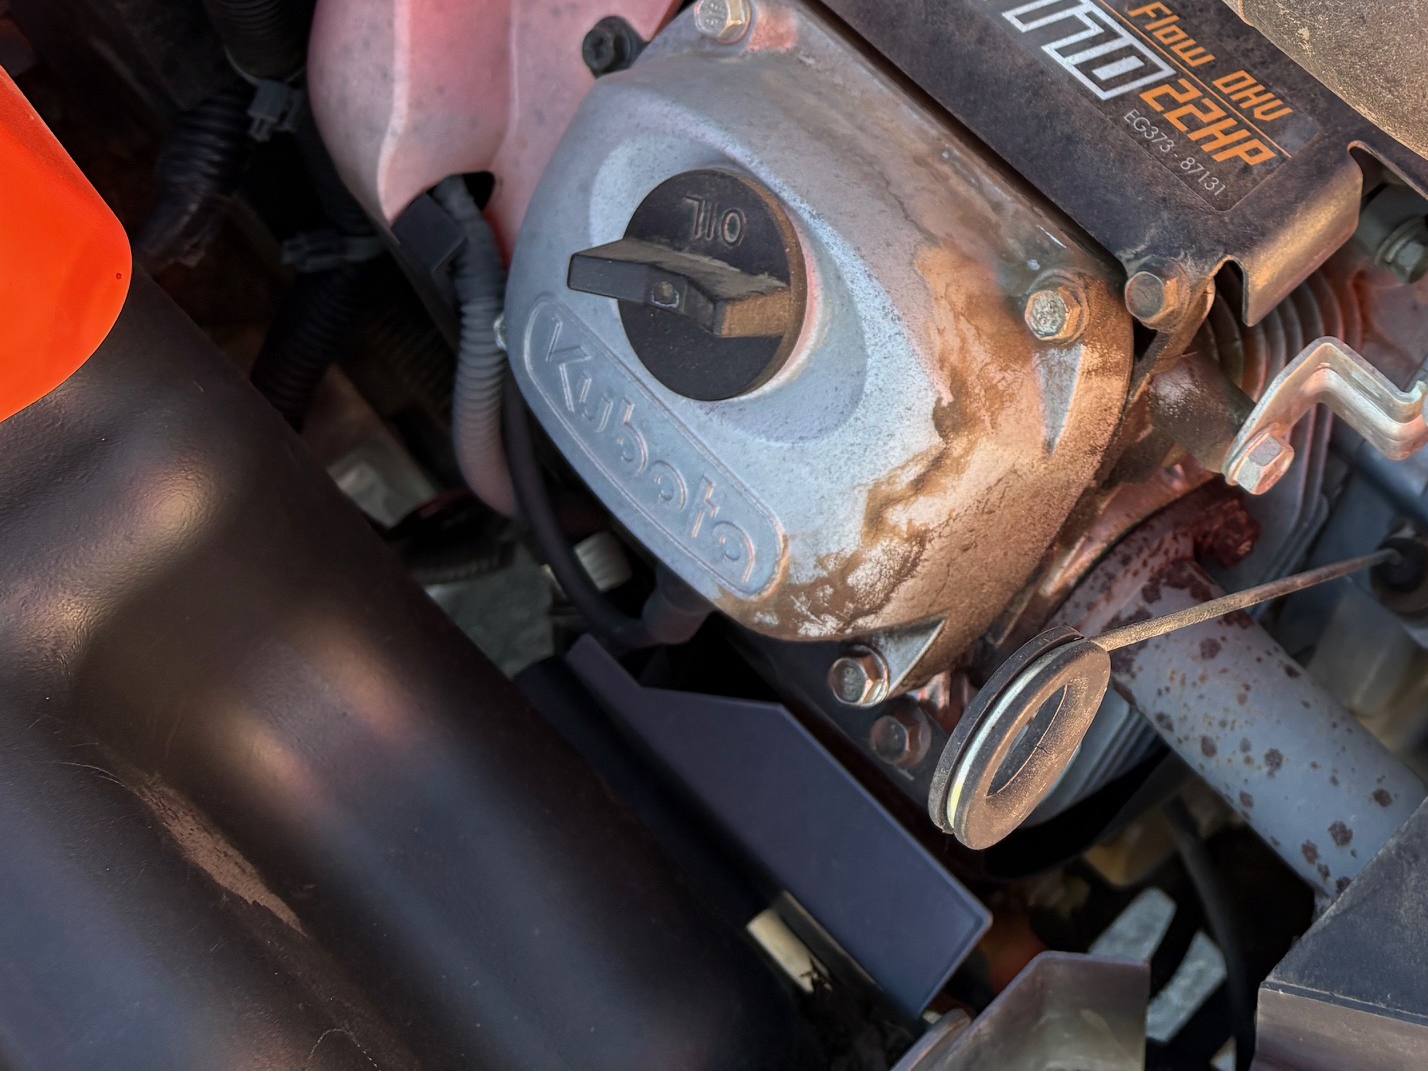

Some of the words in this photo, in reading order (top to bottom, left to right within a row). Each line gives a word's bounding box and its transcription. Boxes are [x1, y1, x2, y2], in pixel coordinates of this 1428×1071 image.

[1127, 1, 1216, 67] Flow
[1212, 70, 1293, 122] OHV
[1123, 108, 1175, 153] EG373
[1180, 157, 1226, 196] 87131
[1139, 78, 1277, 166] 22HP
[545, 317, 756, 586] Kubota
